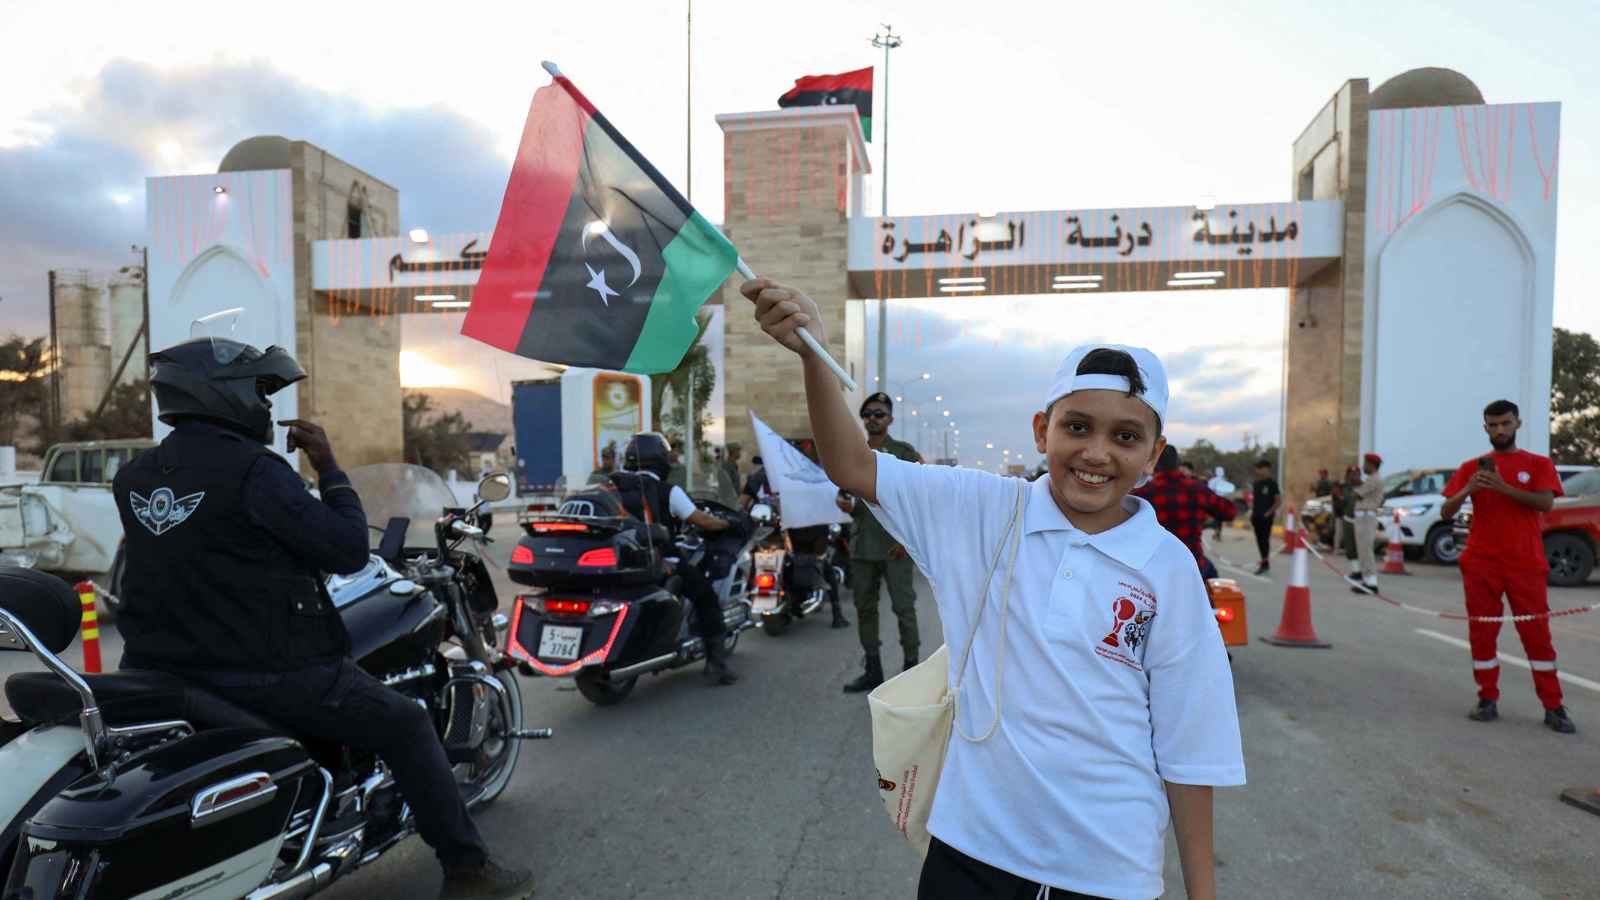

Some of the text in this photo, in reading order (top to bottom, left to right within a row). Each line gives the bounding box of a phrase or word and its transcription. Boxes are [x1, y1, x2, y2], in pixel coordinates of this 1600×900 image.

[881, 209, 1298, 262] مدينة درنة الزاهرة
